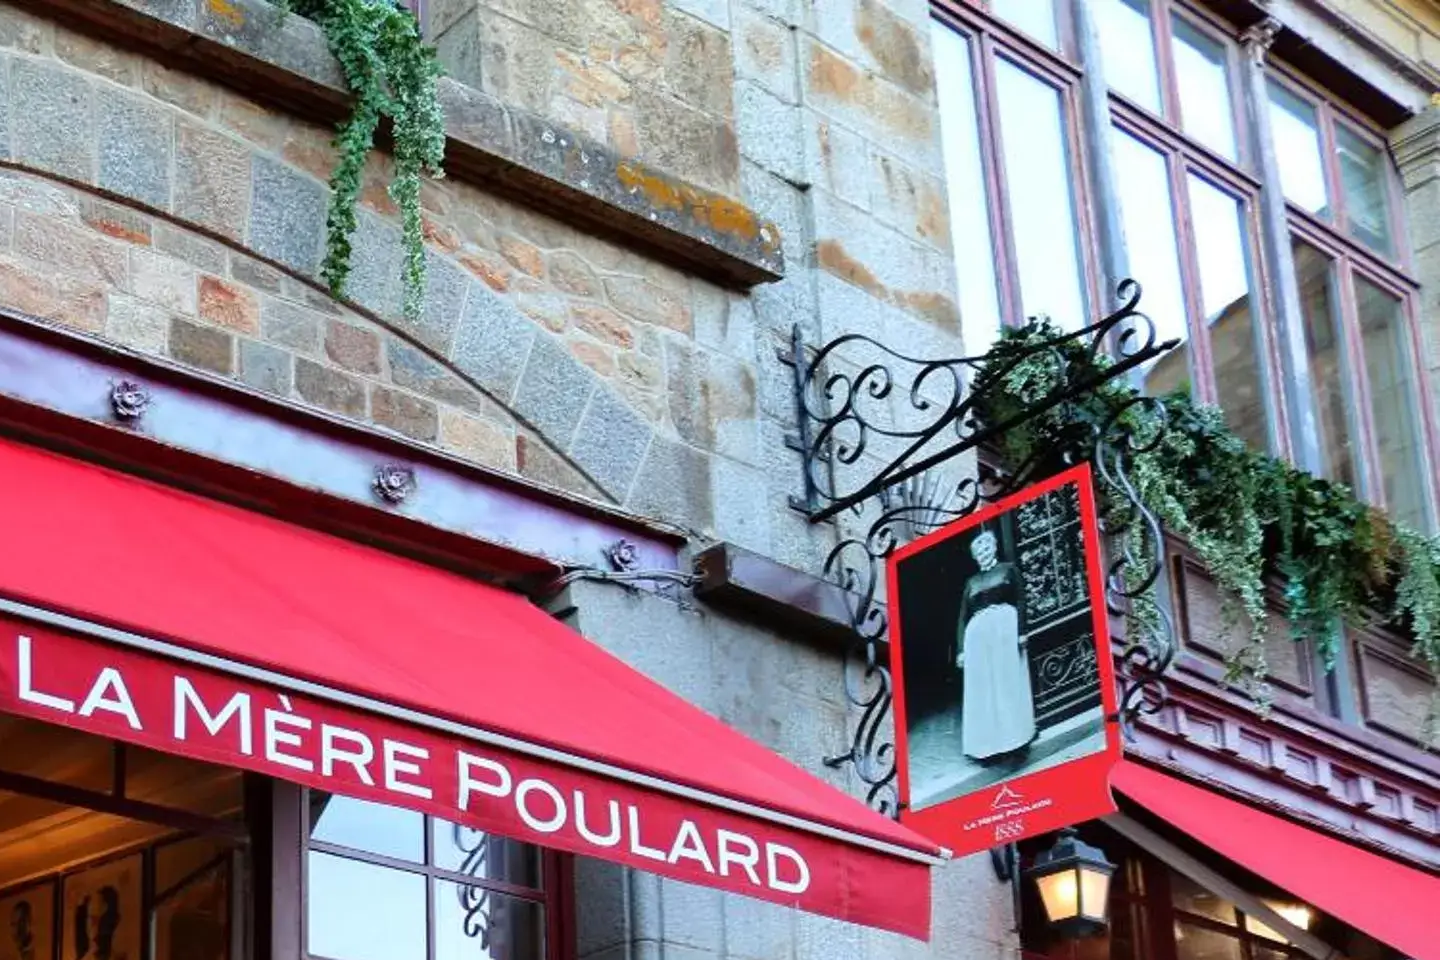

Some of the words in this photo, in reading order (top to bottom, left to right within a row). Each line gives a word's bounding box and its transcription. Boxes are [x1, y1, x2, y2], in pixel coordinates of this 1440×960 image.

[18, 635, 143, 731] LA
[174, 675, 433, 800] MÈRE
[458, 750, 810, 894] POULARD
